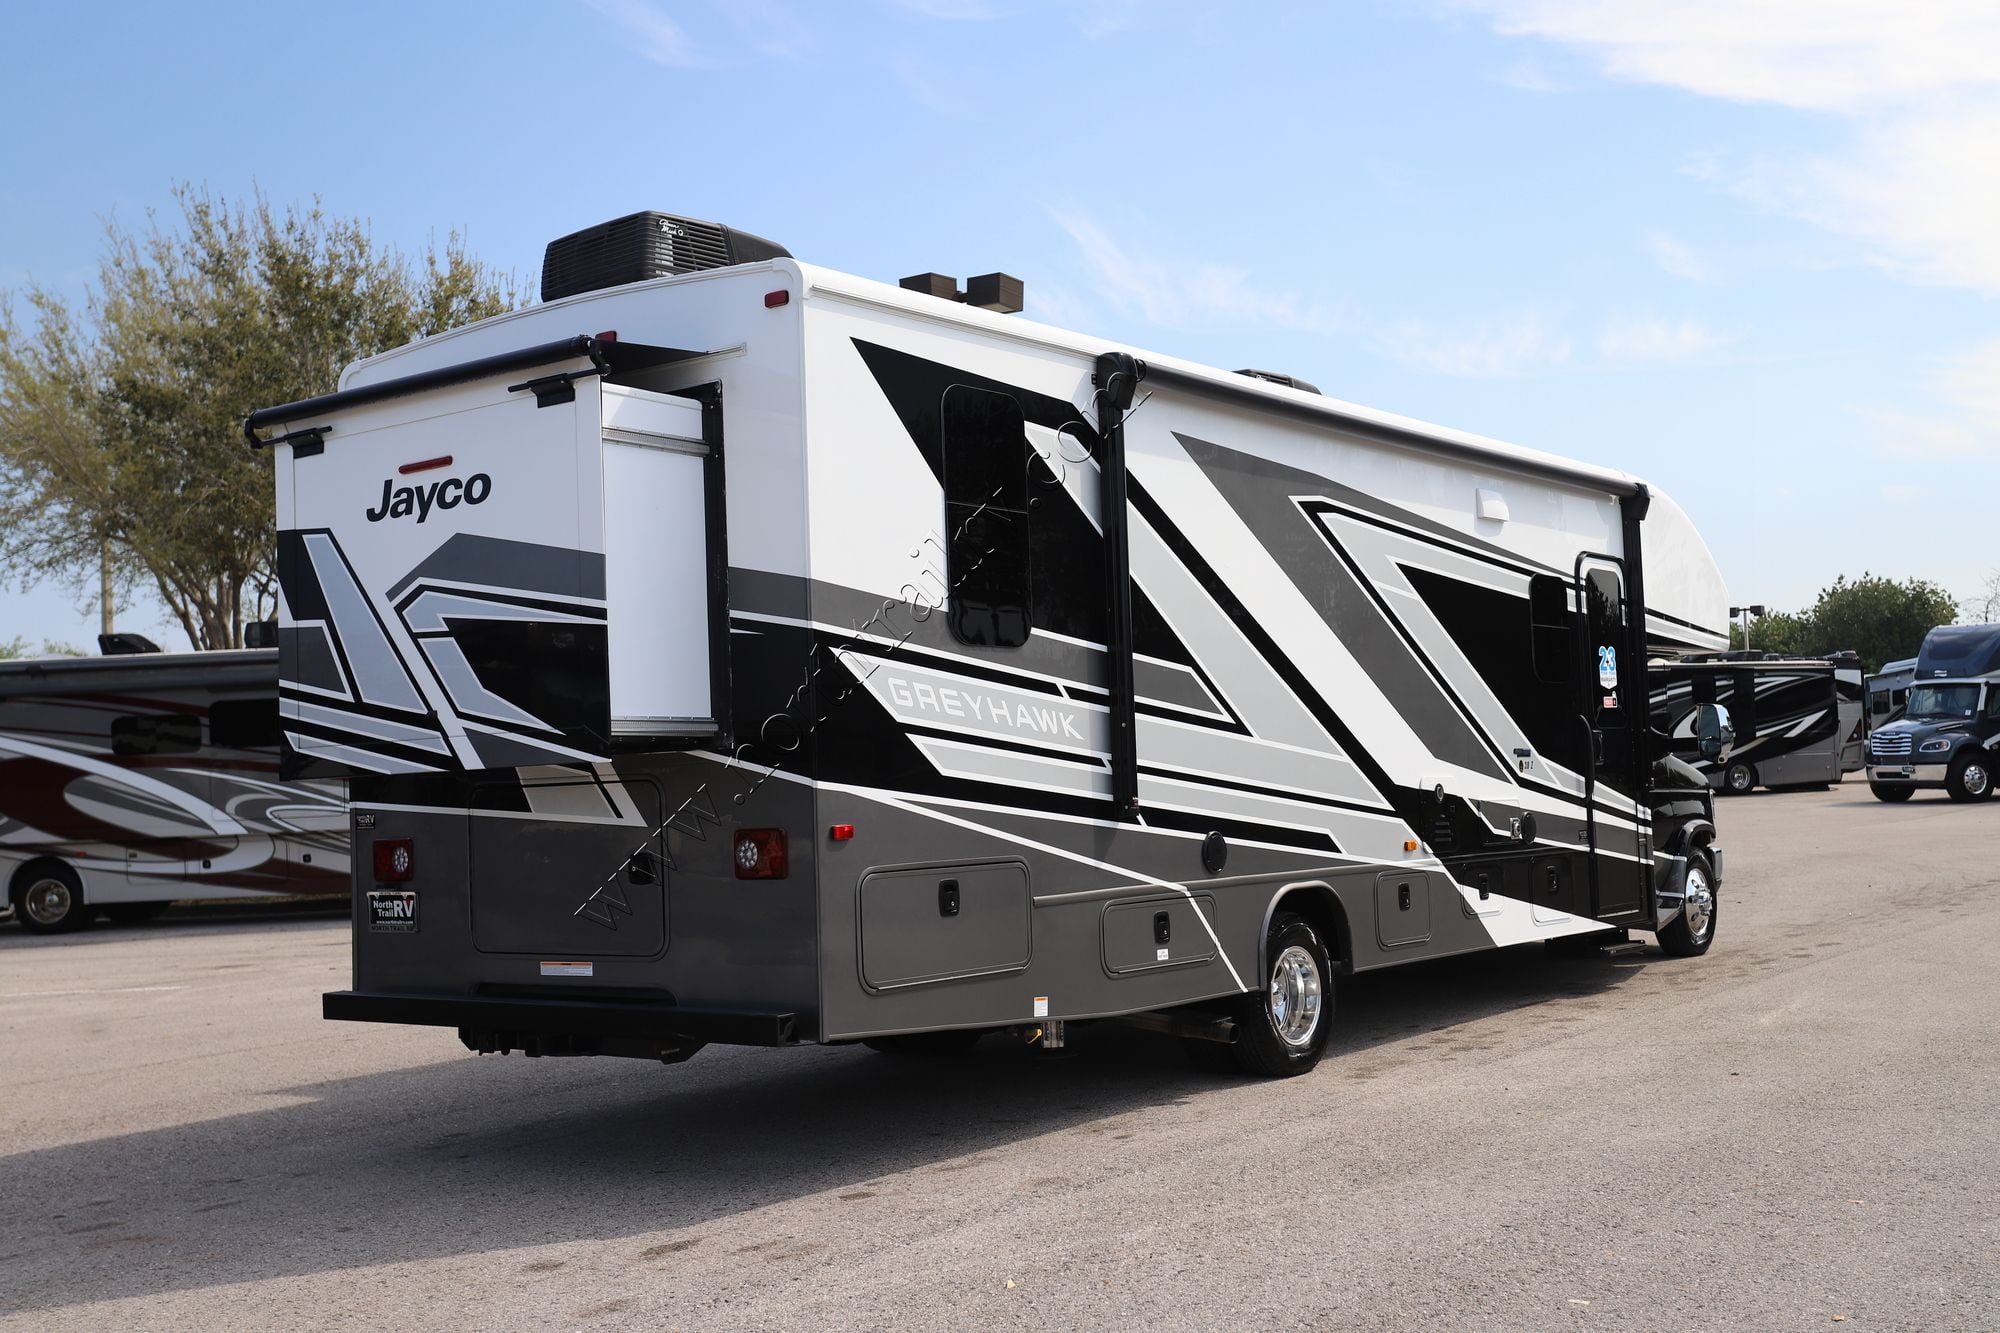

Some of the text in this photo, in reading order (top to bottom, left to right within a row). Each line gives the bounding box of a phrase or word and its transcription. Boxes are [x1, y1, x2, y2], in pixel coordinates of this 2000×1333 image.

[366, 473, 492, 524] Jayco
[887, 677, 1085, 741] GREYHAWK
[373, 900, 414, 917] North RV
[377, 909, 393, 917] Trail
